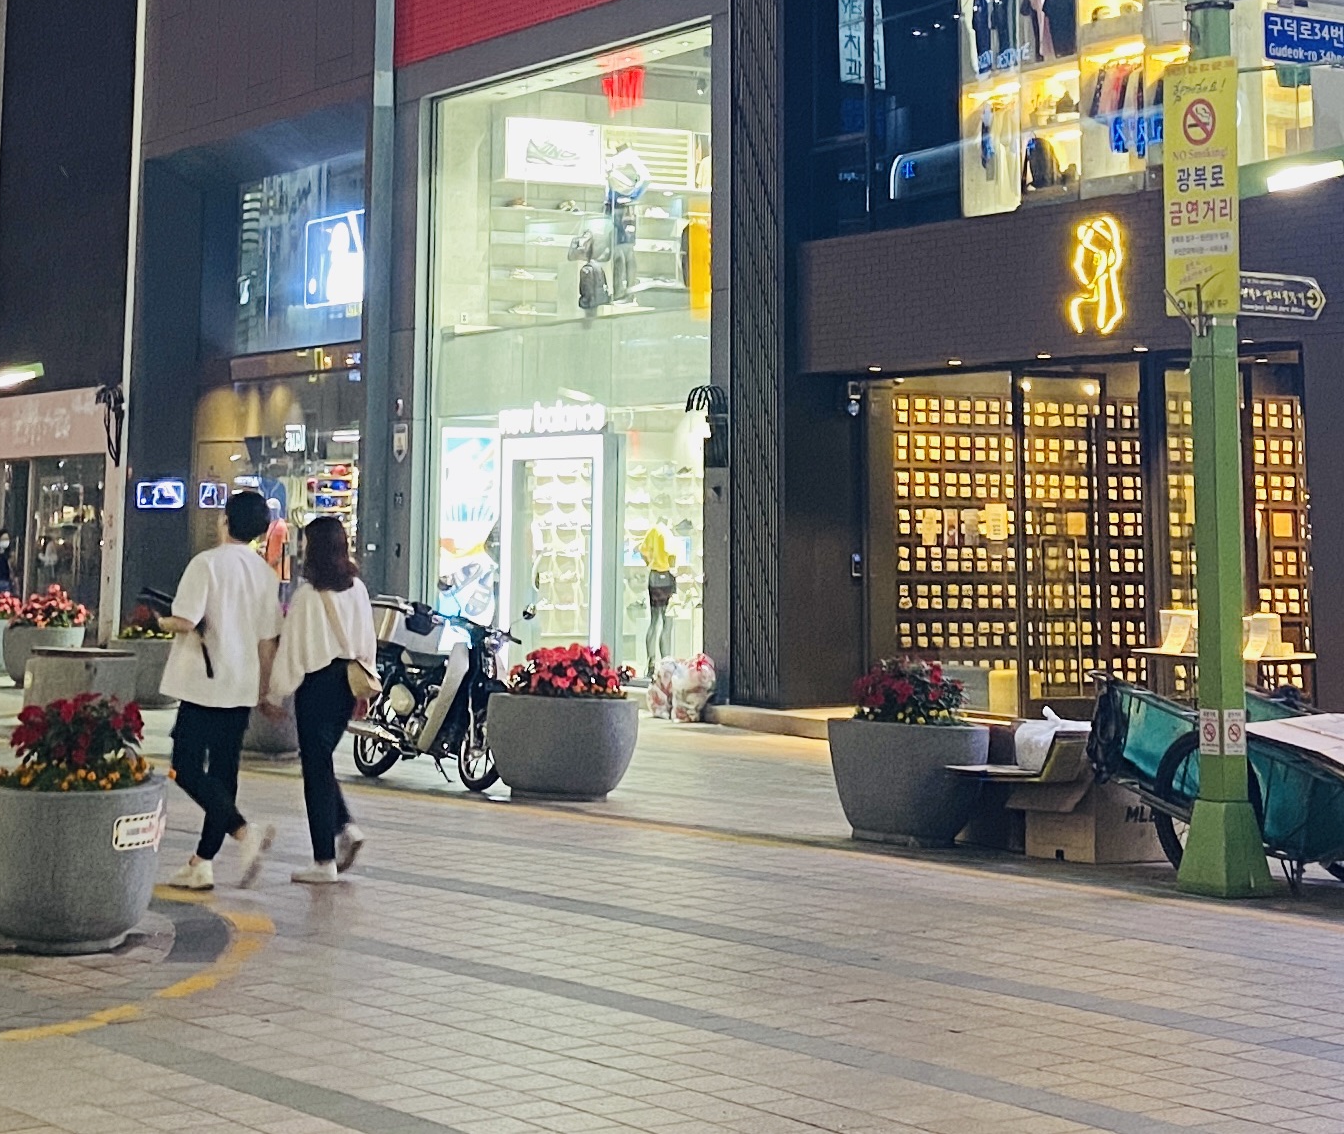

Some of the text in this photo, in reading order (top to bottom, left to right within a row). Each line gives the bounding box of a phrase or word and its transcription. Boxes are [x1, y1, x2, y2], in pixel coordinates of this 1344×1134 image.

[1269, 43, 1317, 62] Gudeok-ro
[1177, 165, 1224, 193] 광복로
[1169, 196, 1233, 226] 금연거리
